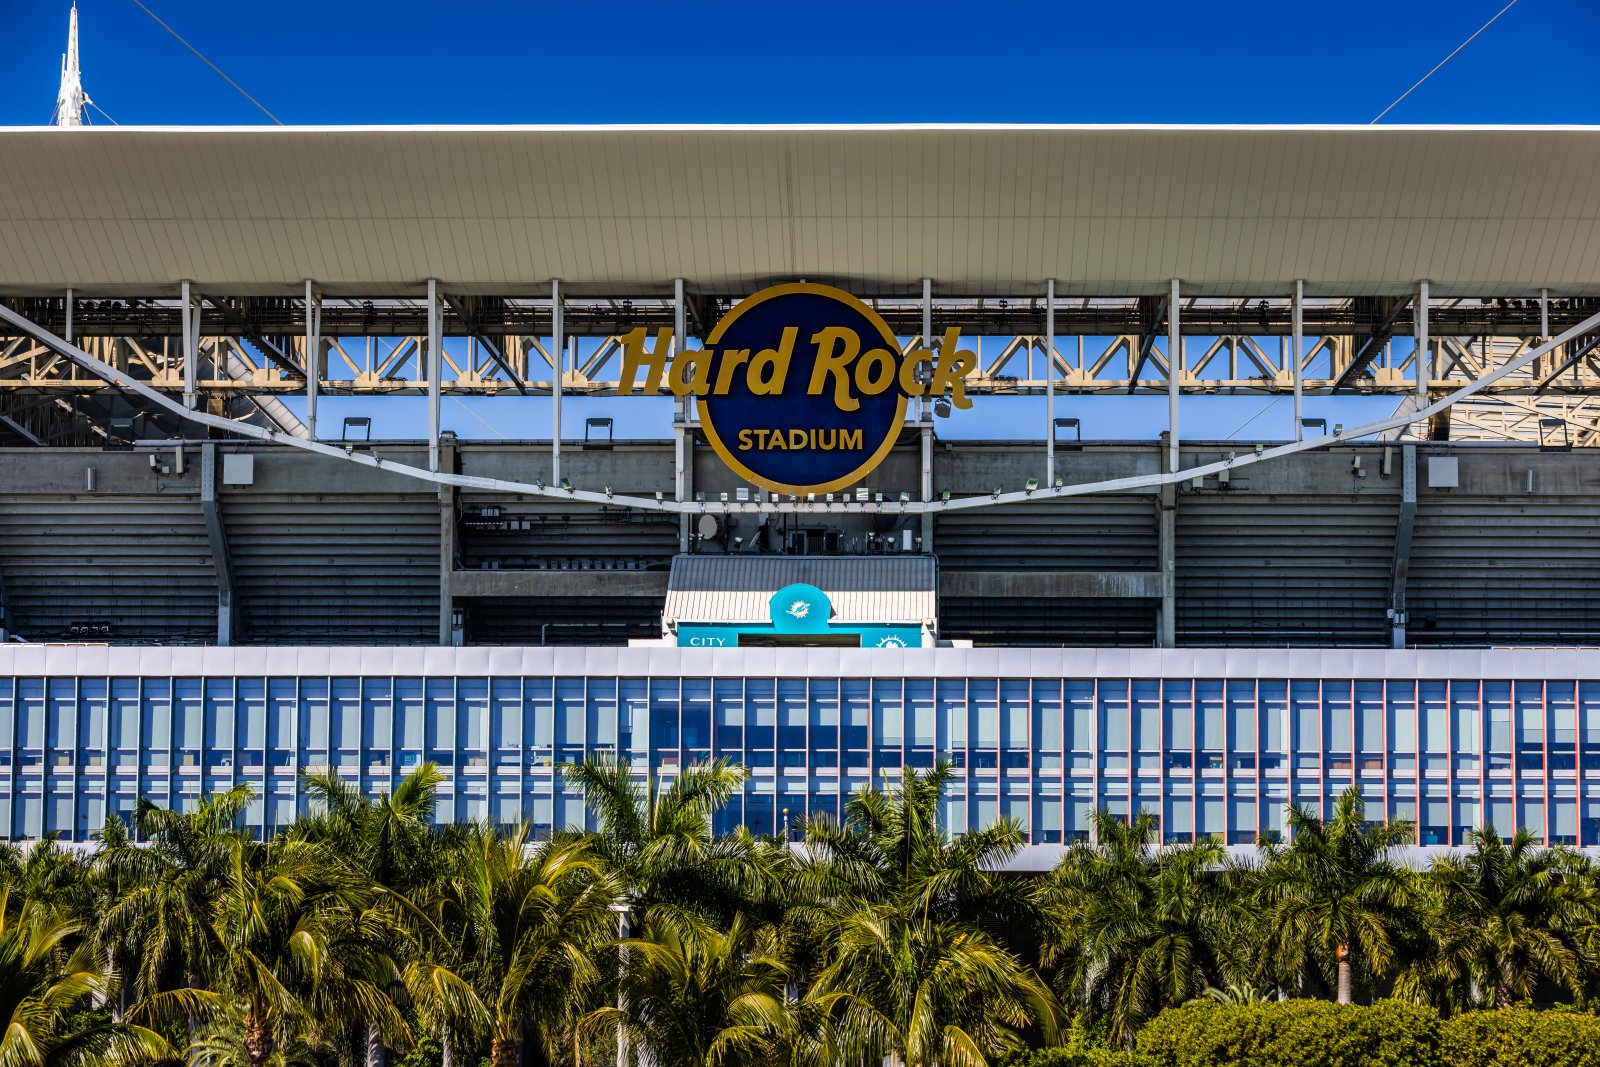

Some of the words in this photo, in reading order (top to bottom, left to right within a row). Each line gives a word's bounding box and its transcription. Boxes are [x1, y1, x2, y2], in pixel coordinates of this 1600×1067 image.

[617, 327, 799, 395] Hard
[807, 327, 977, 411] Rock
[738, 429, 863, 450] STADIUM
[690, 637, 726, 647] CITY
